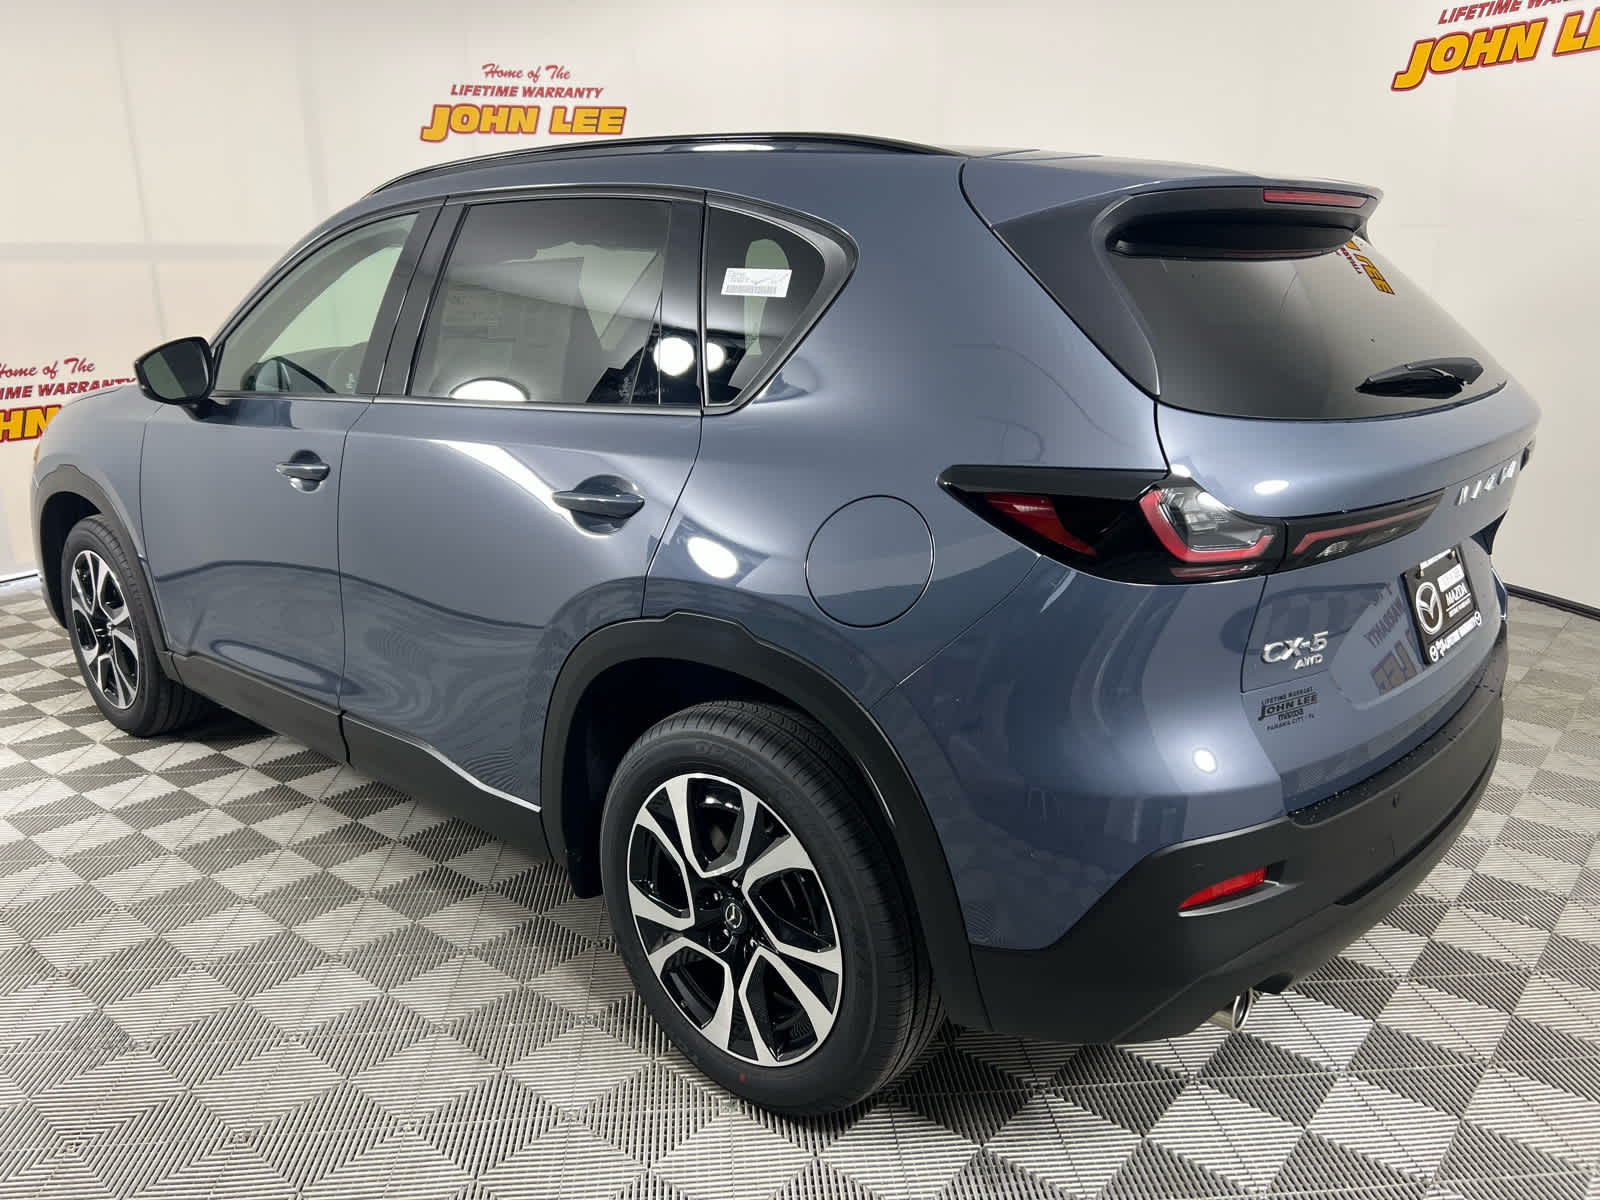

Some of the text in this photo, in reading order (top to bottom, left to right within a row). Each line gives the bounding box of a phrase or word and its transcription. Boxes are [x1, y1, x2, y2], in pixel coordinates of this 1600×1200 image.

[1438, 0, 1522, 24] LIFETIME
[1390, 17, 1548, 92] JOHN
[482, 63, 571, 83] Home of The
[451, 84, 604, 98] LIFETIME WARRANTY
[420, 103, 627, 142] JOHN LEE
[42, 360, 58, 380] of
[64, 358, 95, 375] The
[1263, 631, 1328, 663] CX-5
[1294, 654, 1323, 670] AWD
[1258, 692, 1318, 721] JOHN LEE
